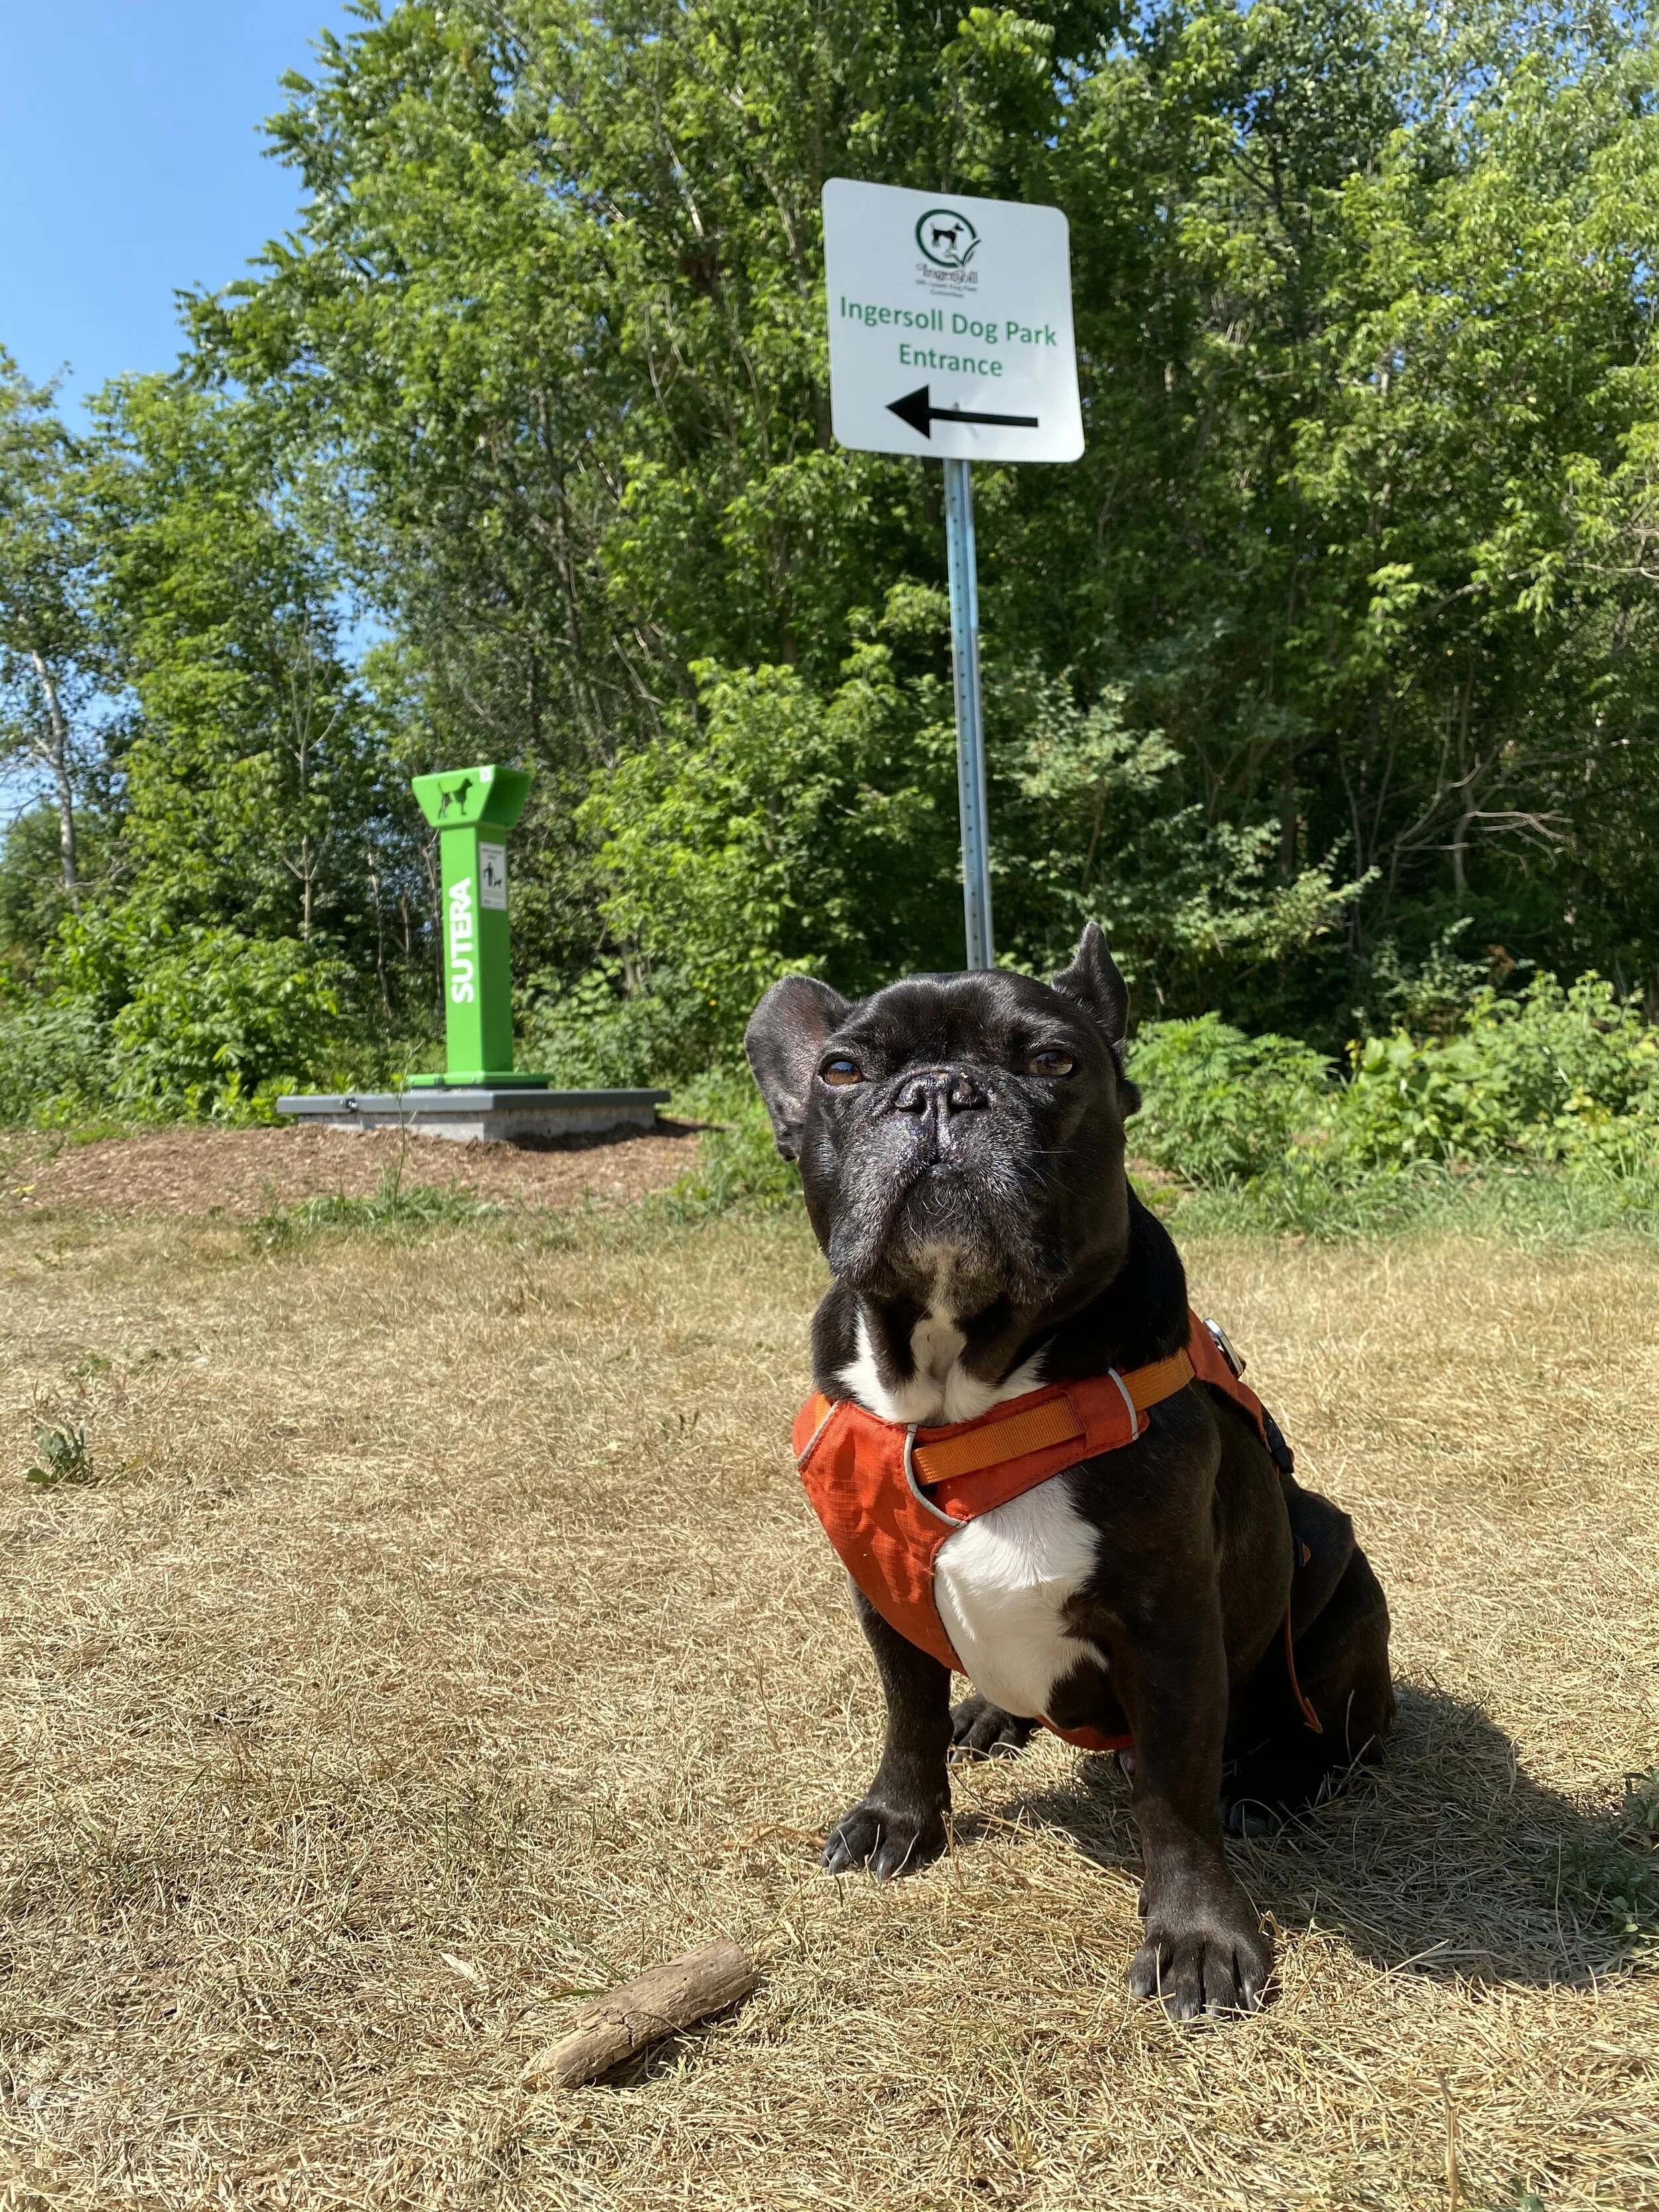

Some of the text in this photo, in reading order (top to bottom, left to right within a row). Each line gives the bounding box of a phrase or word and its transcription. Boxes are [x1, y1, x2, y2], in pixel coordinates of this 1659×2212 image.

[841, 297, 1056, 346] Ingersoll Dog Park
[899, 344, 1003, 377] Entrance
[449, 877, 474, 1004] SUTERA
